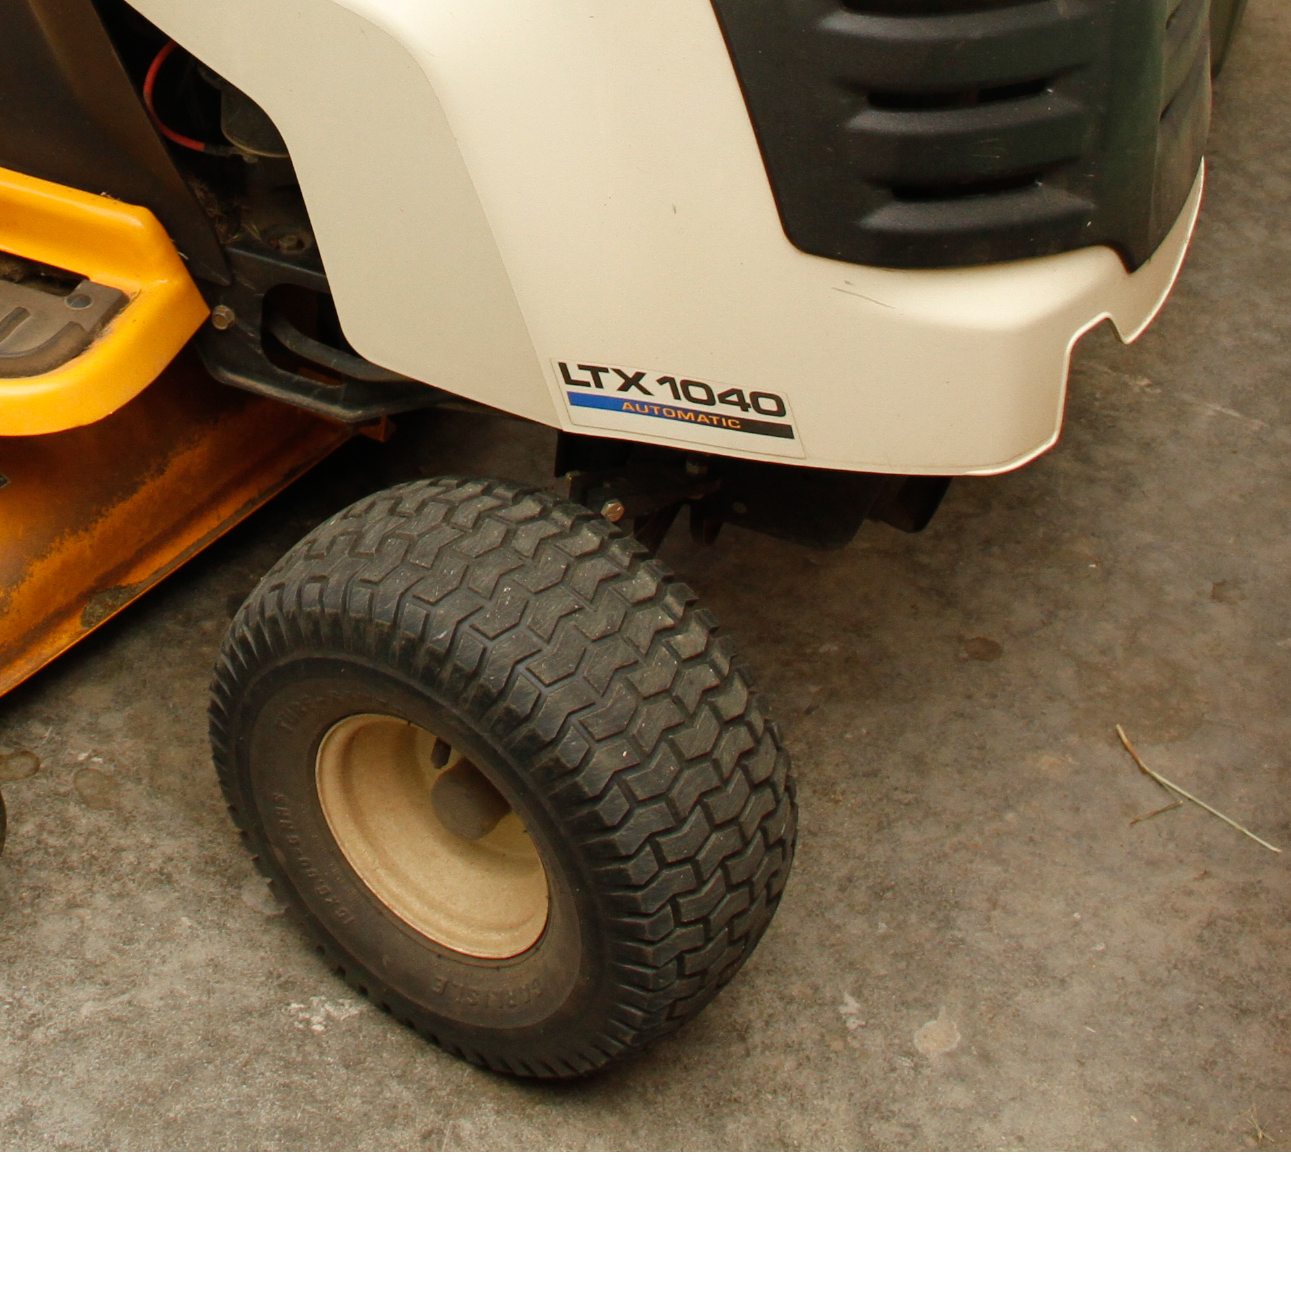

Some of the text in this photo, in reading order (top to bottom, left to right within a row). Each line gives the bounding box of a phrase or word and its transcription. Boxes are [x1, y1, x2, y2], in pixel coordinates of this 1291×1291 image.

[558, 361, 787, 418] LTX 1040
[622, 401, 742, 430] AUTOMATIC
